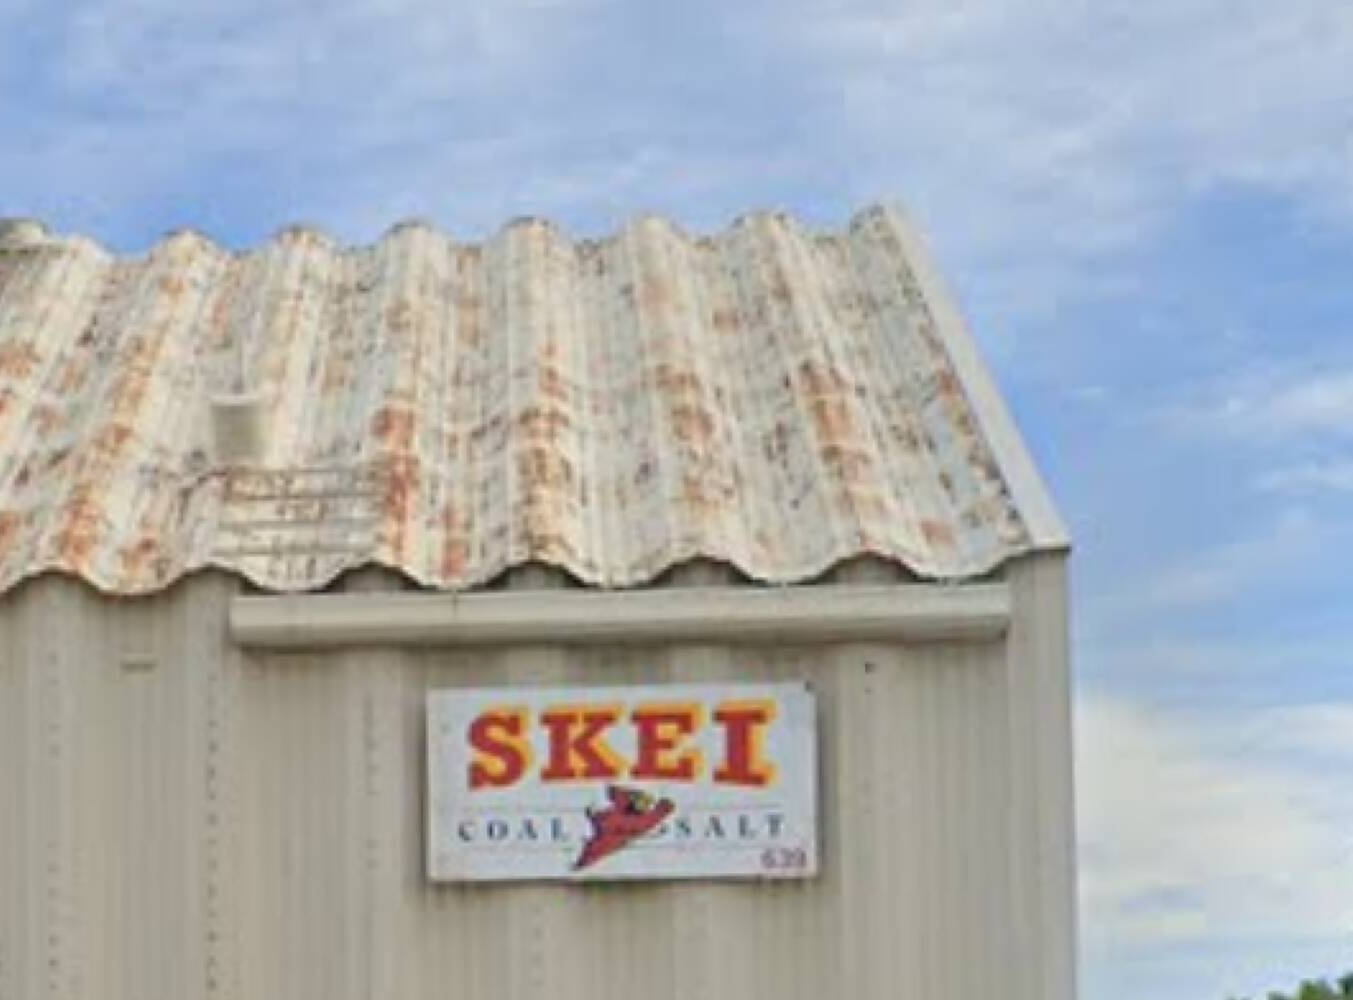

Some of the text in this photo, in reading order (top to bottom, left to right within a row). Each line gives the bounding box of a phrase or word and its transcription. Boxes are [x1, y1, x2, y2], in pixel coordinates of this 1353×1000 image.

[467, 701, 778, 790] SKEI
[457, 812, 785, 842] COAL SALT
